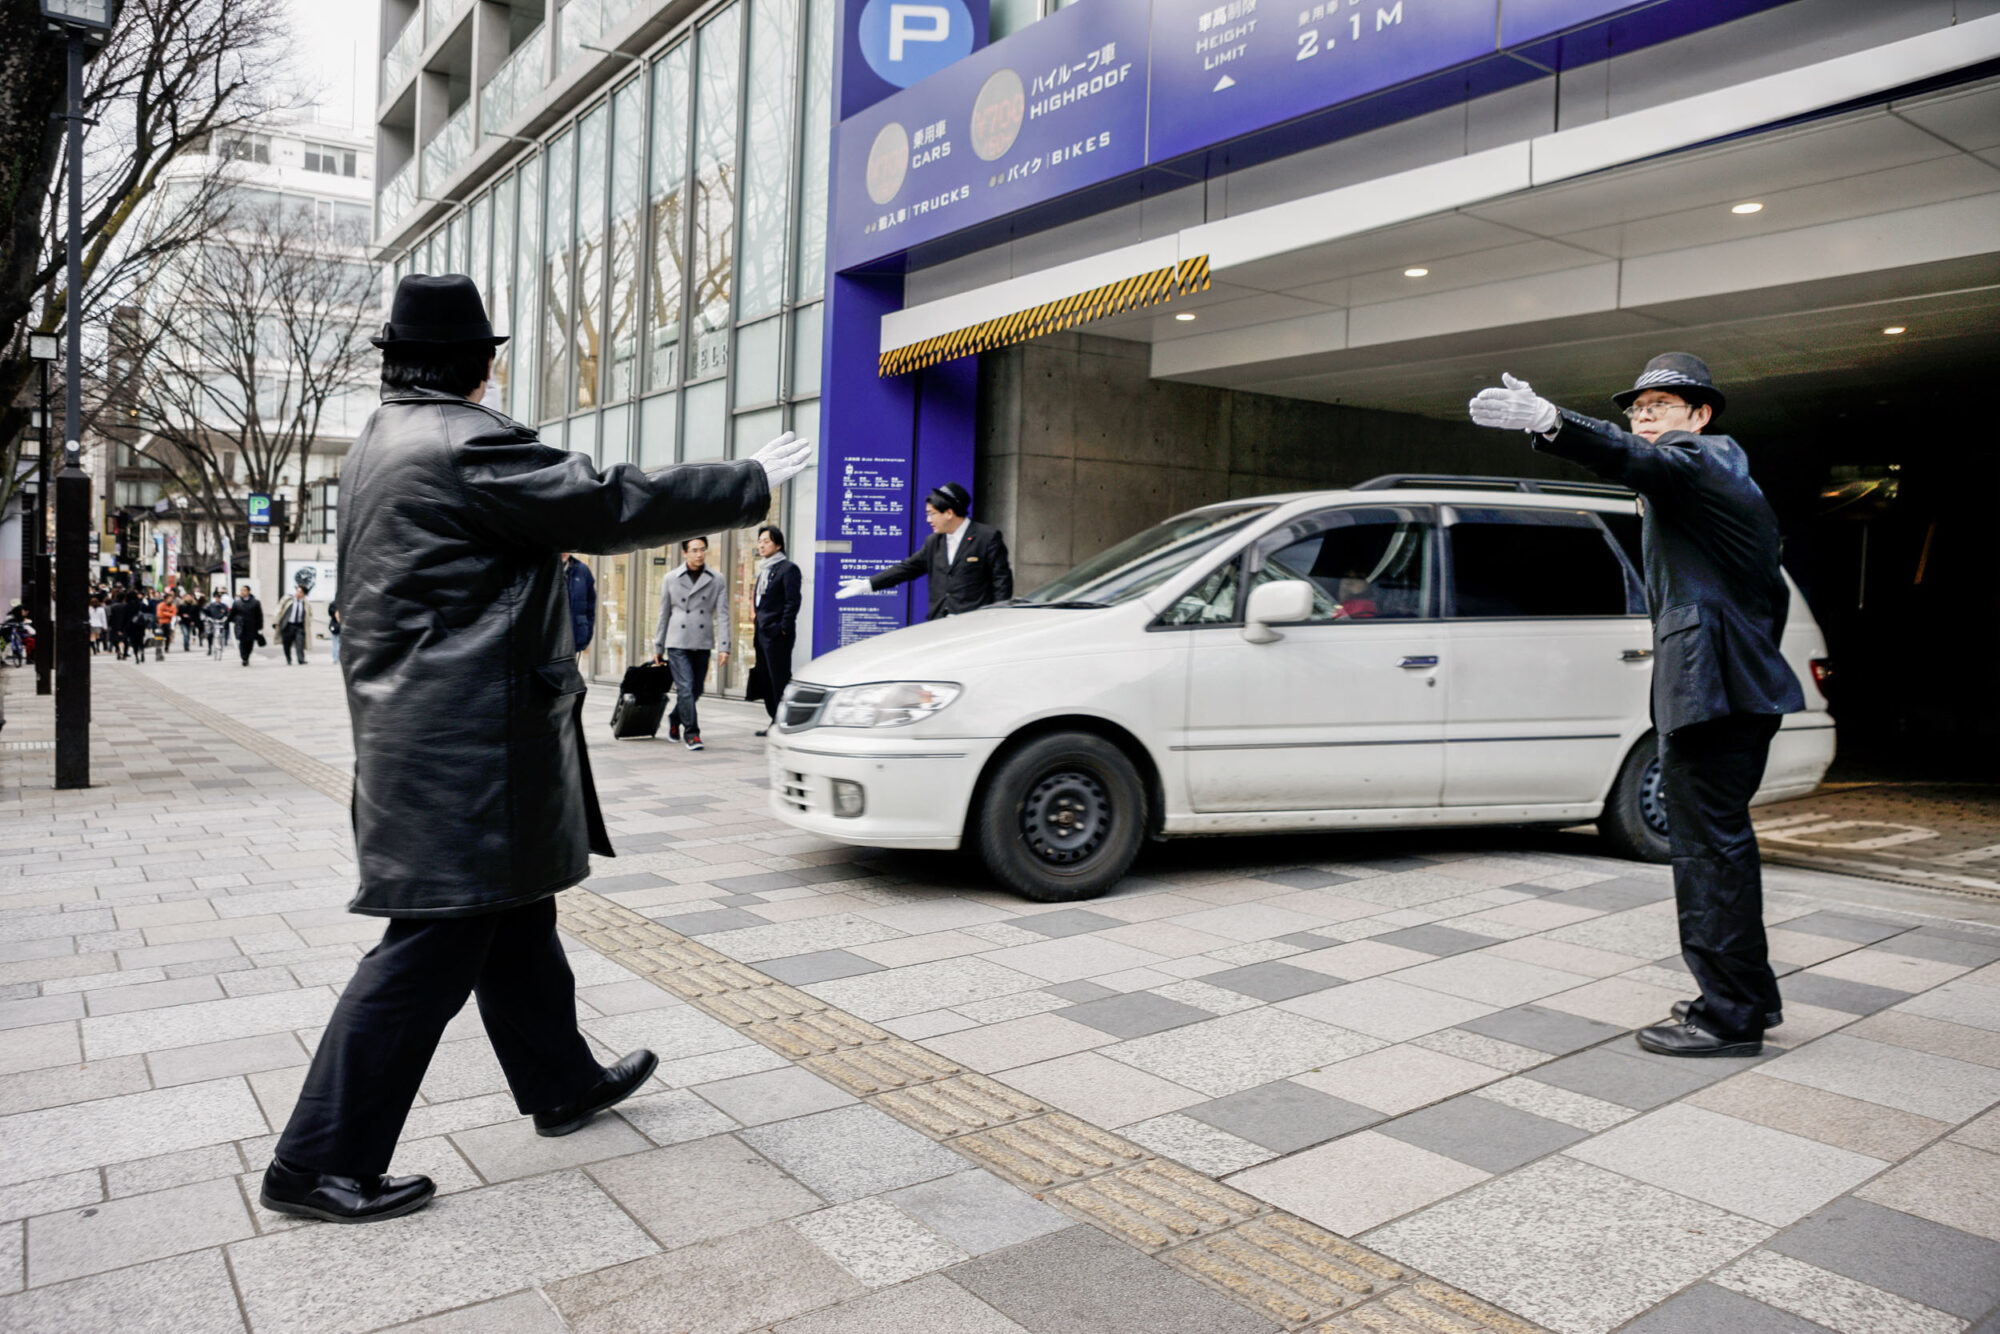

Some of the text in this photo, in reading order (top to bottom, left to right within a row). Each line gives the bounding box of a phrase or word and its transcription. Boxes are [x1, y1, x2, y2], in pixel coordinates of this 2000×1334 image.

[889, 4, 950, 61] P
[1196, 19, 1258, 54] HEIGHT
[1031, 42, 1116, 96] ハイルーフ車
[1204, 43, 1248, 71] LIMIT
[1030, 63, 1132, 120] HIGHROOF
[912, 141, 951, 169] CARS
[1007, 131, 1111, 182] バイク BIKES
[912, 184, 970, 216] TRUCKS
[249, 496, 270, 516] P
